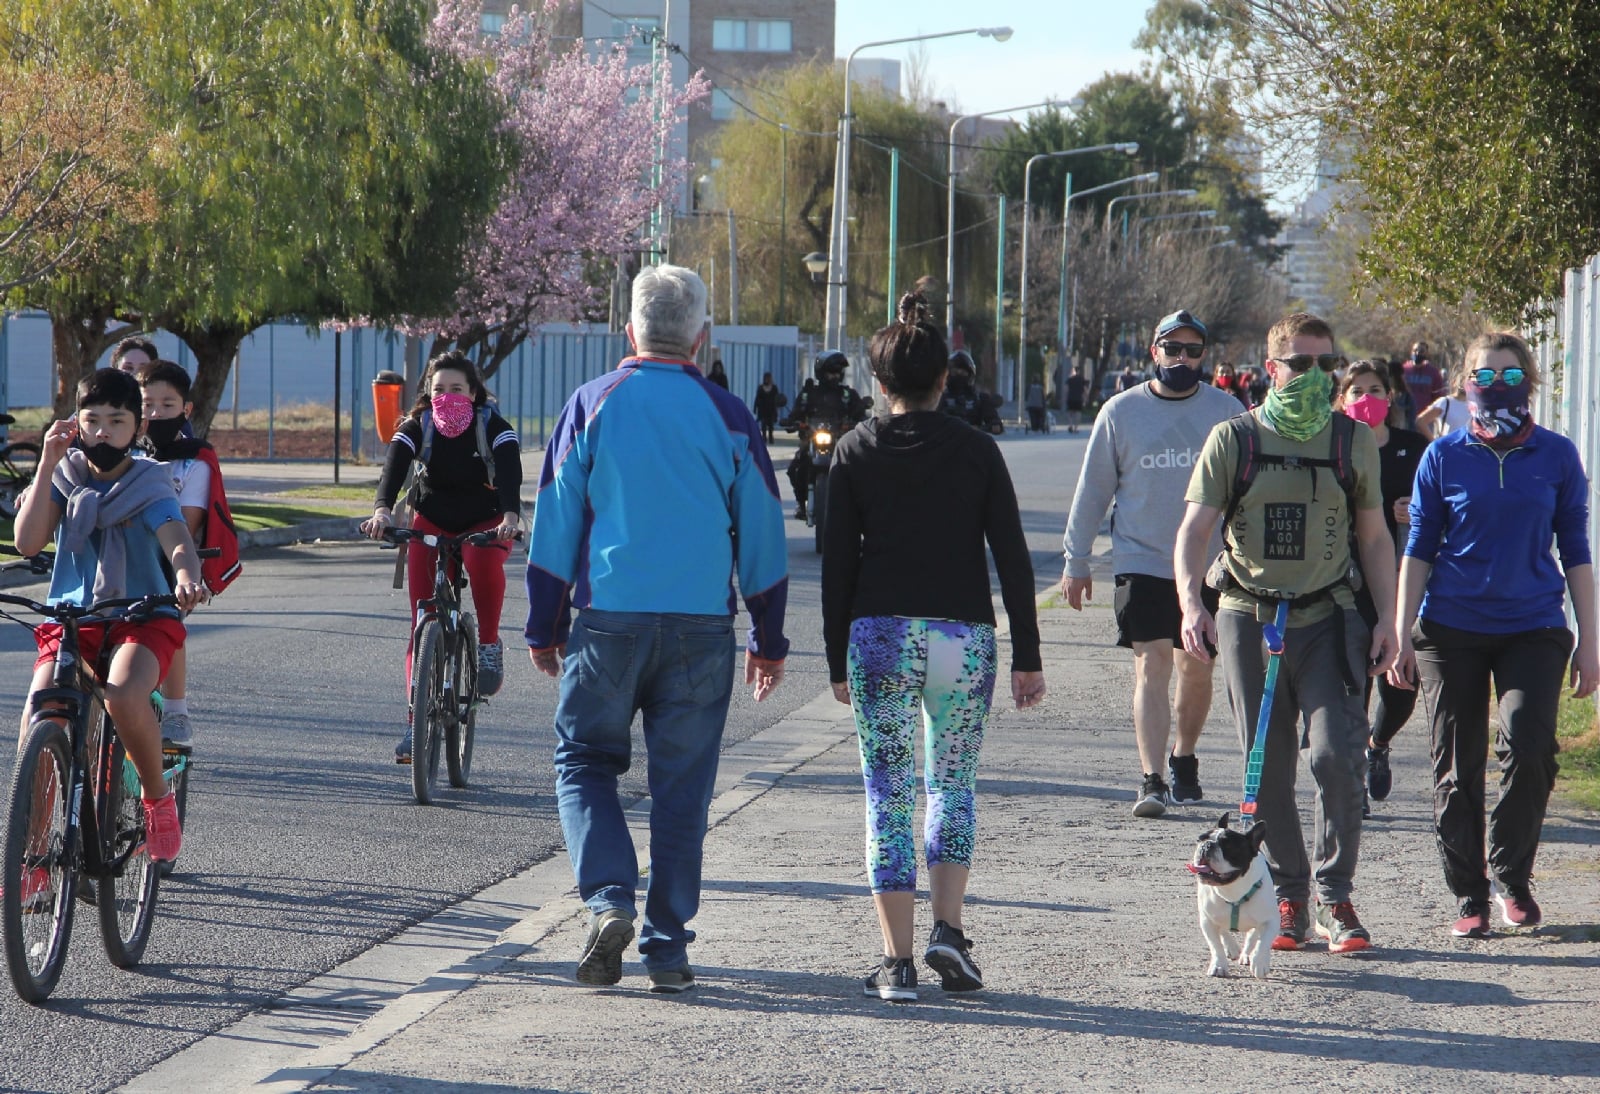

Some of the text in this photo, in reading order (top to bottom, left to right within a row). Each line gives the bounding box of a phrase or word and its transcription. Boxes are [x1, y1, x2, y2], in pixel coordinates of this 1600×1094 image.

[1271, 519, 1301, 531] JUST
[1276, 532, 1294, 543] GO
[1323, 505, 1340, 561] TOKYO
[1268, 543, 1301, 556] AWAY
